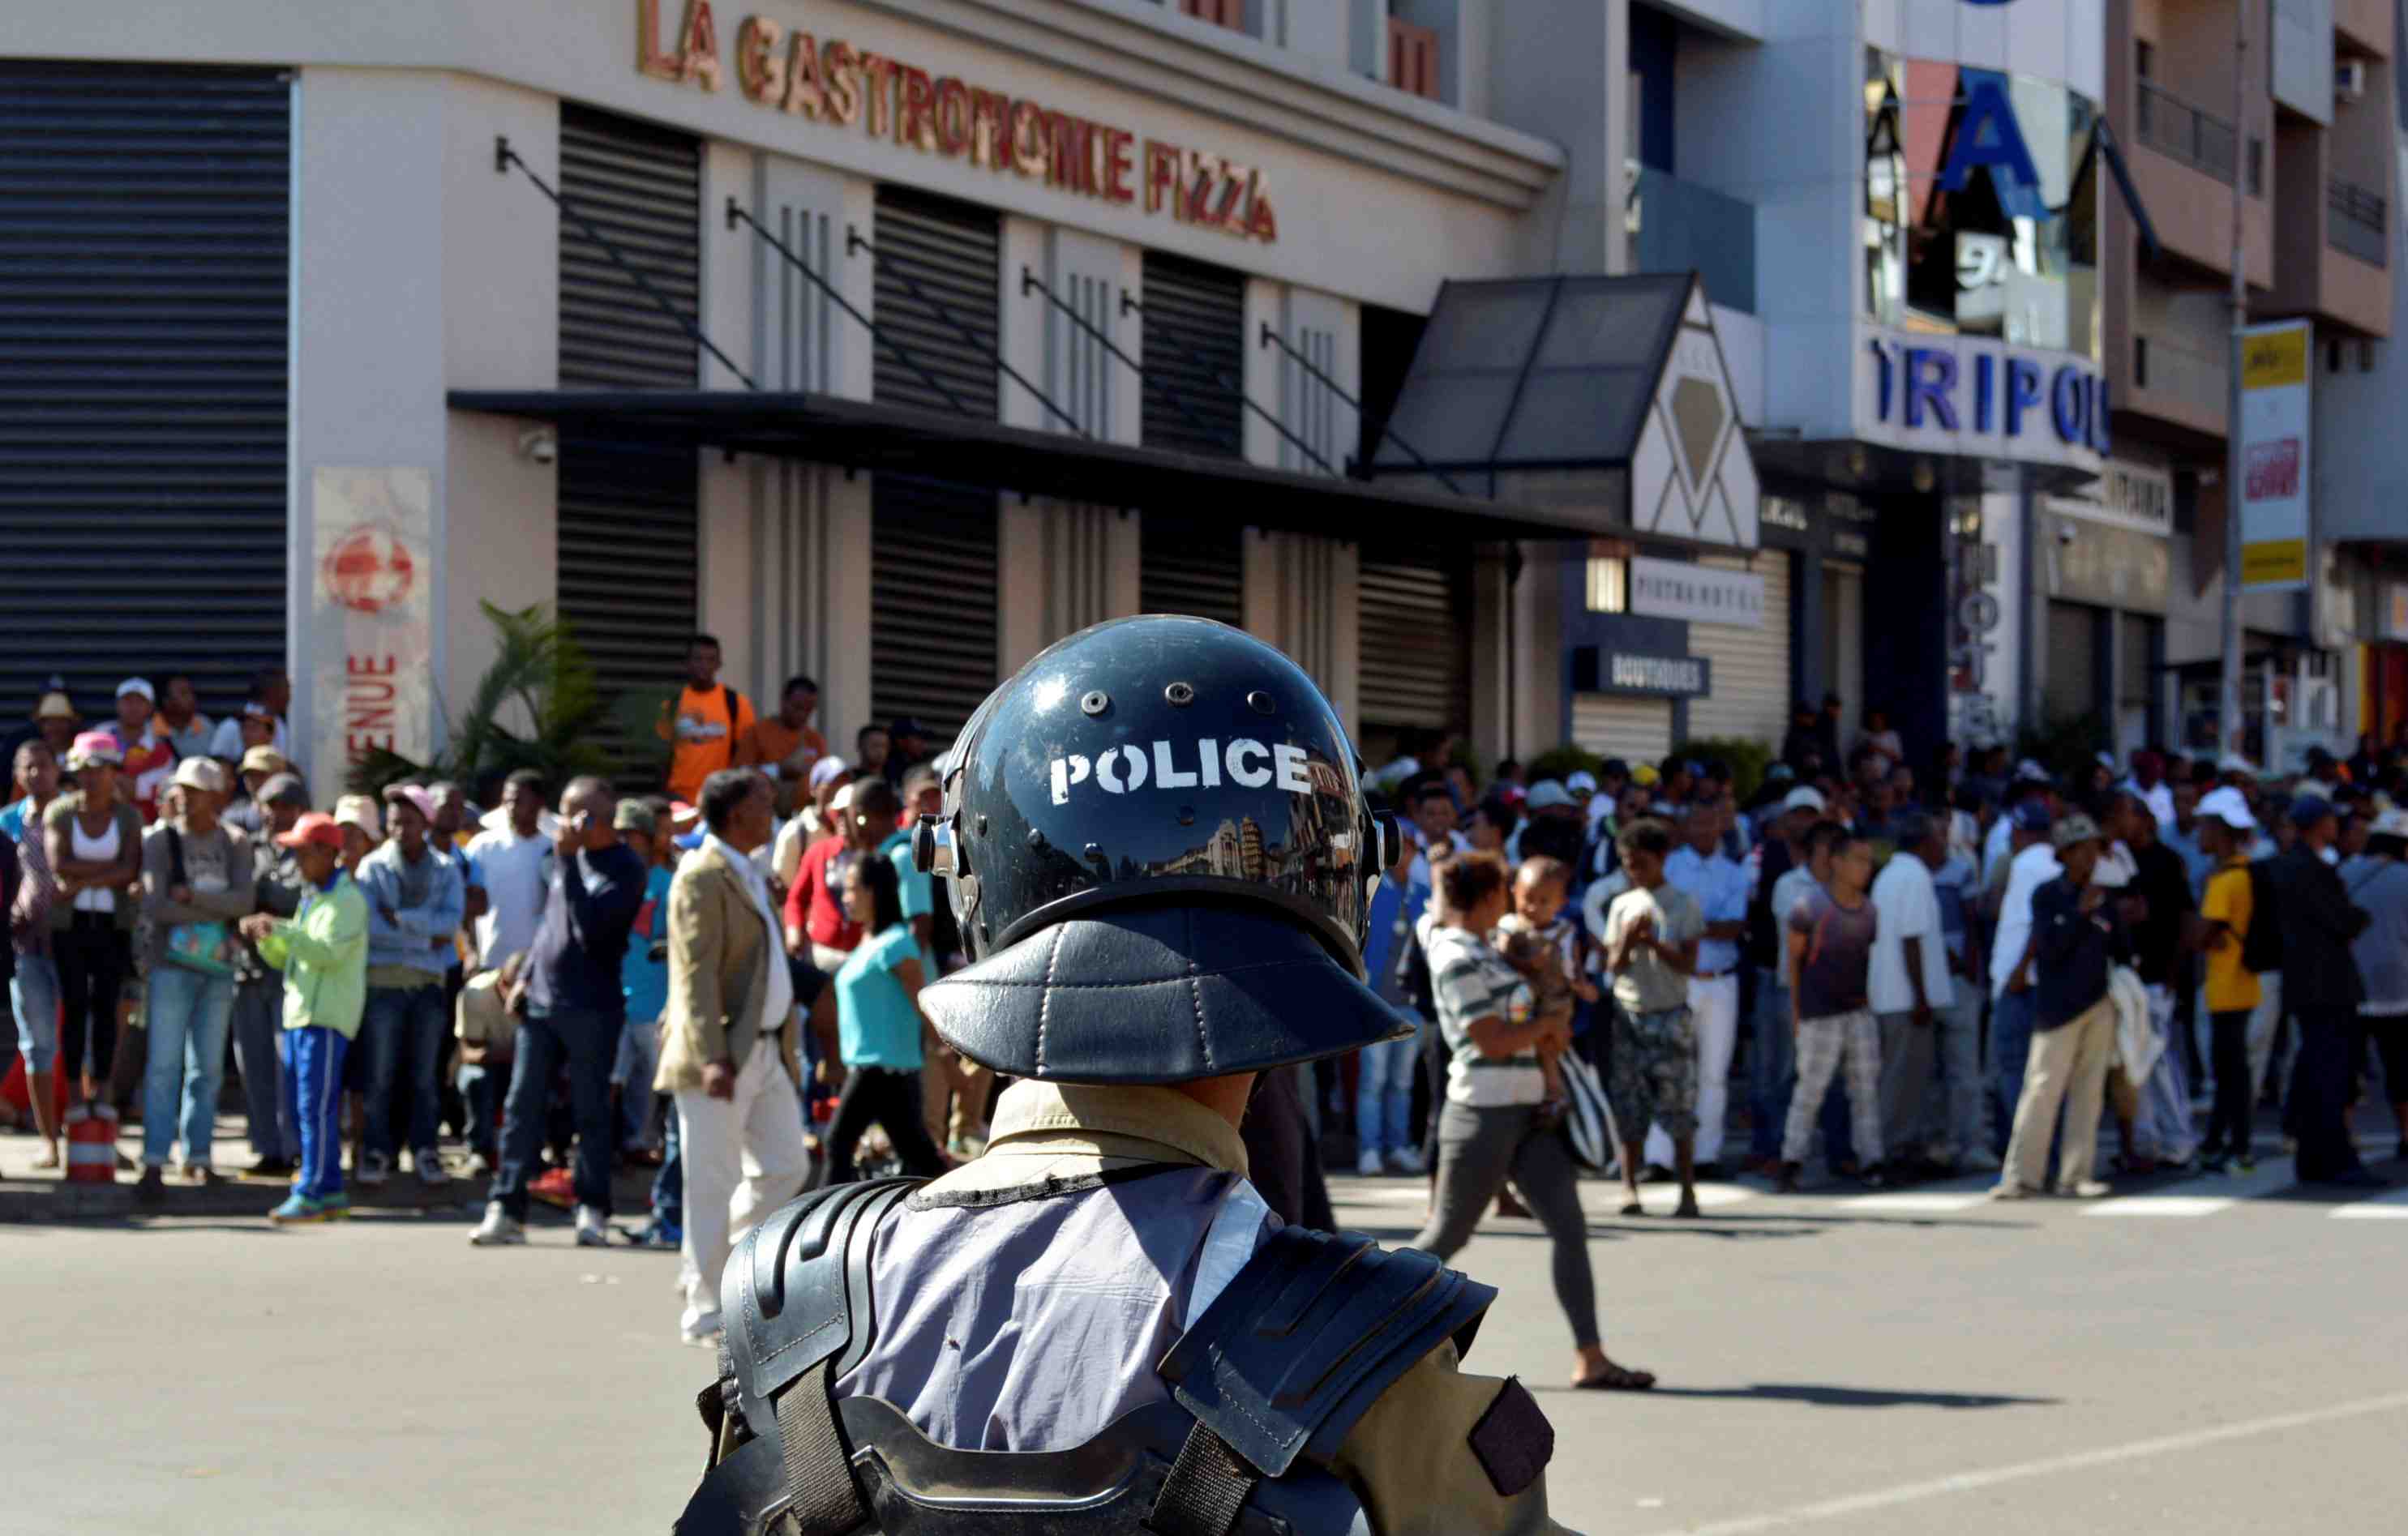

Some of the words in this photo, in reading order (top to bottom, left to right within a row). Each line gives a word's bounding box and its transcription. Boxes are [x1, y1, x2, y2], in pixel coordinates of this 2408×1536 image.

[636, 0, 722, 92] LA
[735, 15, 1133, 204] GASTRONOMIE
[1144, 139, 1278, 244] PIZZA
[346, 654, 396, 770] ENUE
[1051, 738, 1312, 806] POLICE
